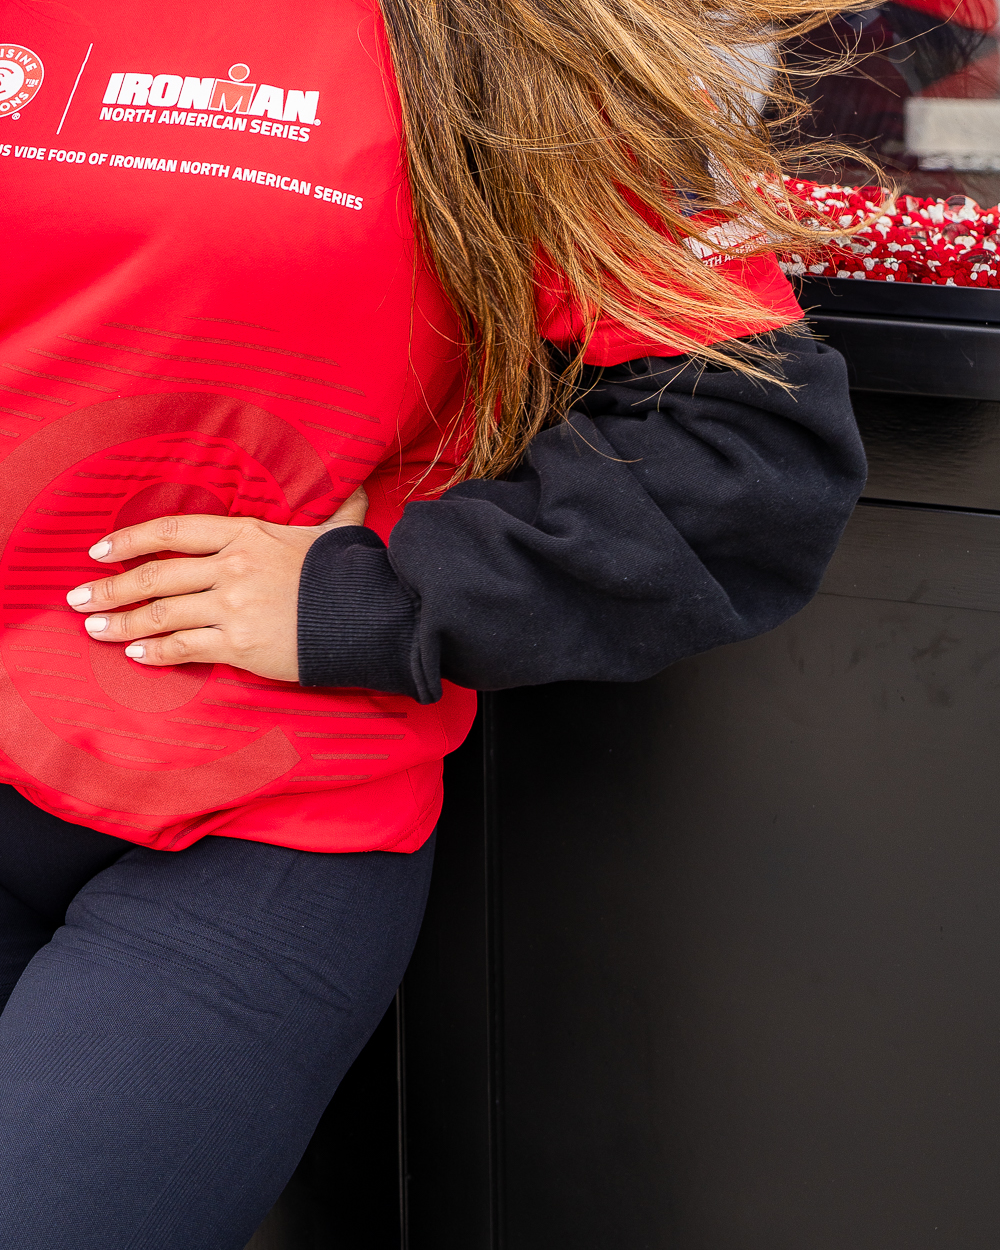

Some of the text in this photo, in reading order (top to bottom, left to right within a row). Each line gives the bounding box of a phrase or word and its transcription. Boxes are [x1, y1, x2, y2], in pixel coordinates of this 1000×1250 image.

[99, 107, 311, 142] NORTH AMERICAN SERIES
[102, 63, 320, 125] IRONMAN
[14, 145, 46, 160] VIDE
[48, 149, 86, 164] FOOD
[88, 152, 109, 165] OF
[109, 154, 178, 172] IRONMAN
[179, 160, 230, 178] NORTH
[231, 167, 311, 195] AMERICAN
[313, 185, 364, 211] SERIES
